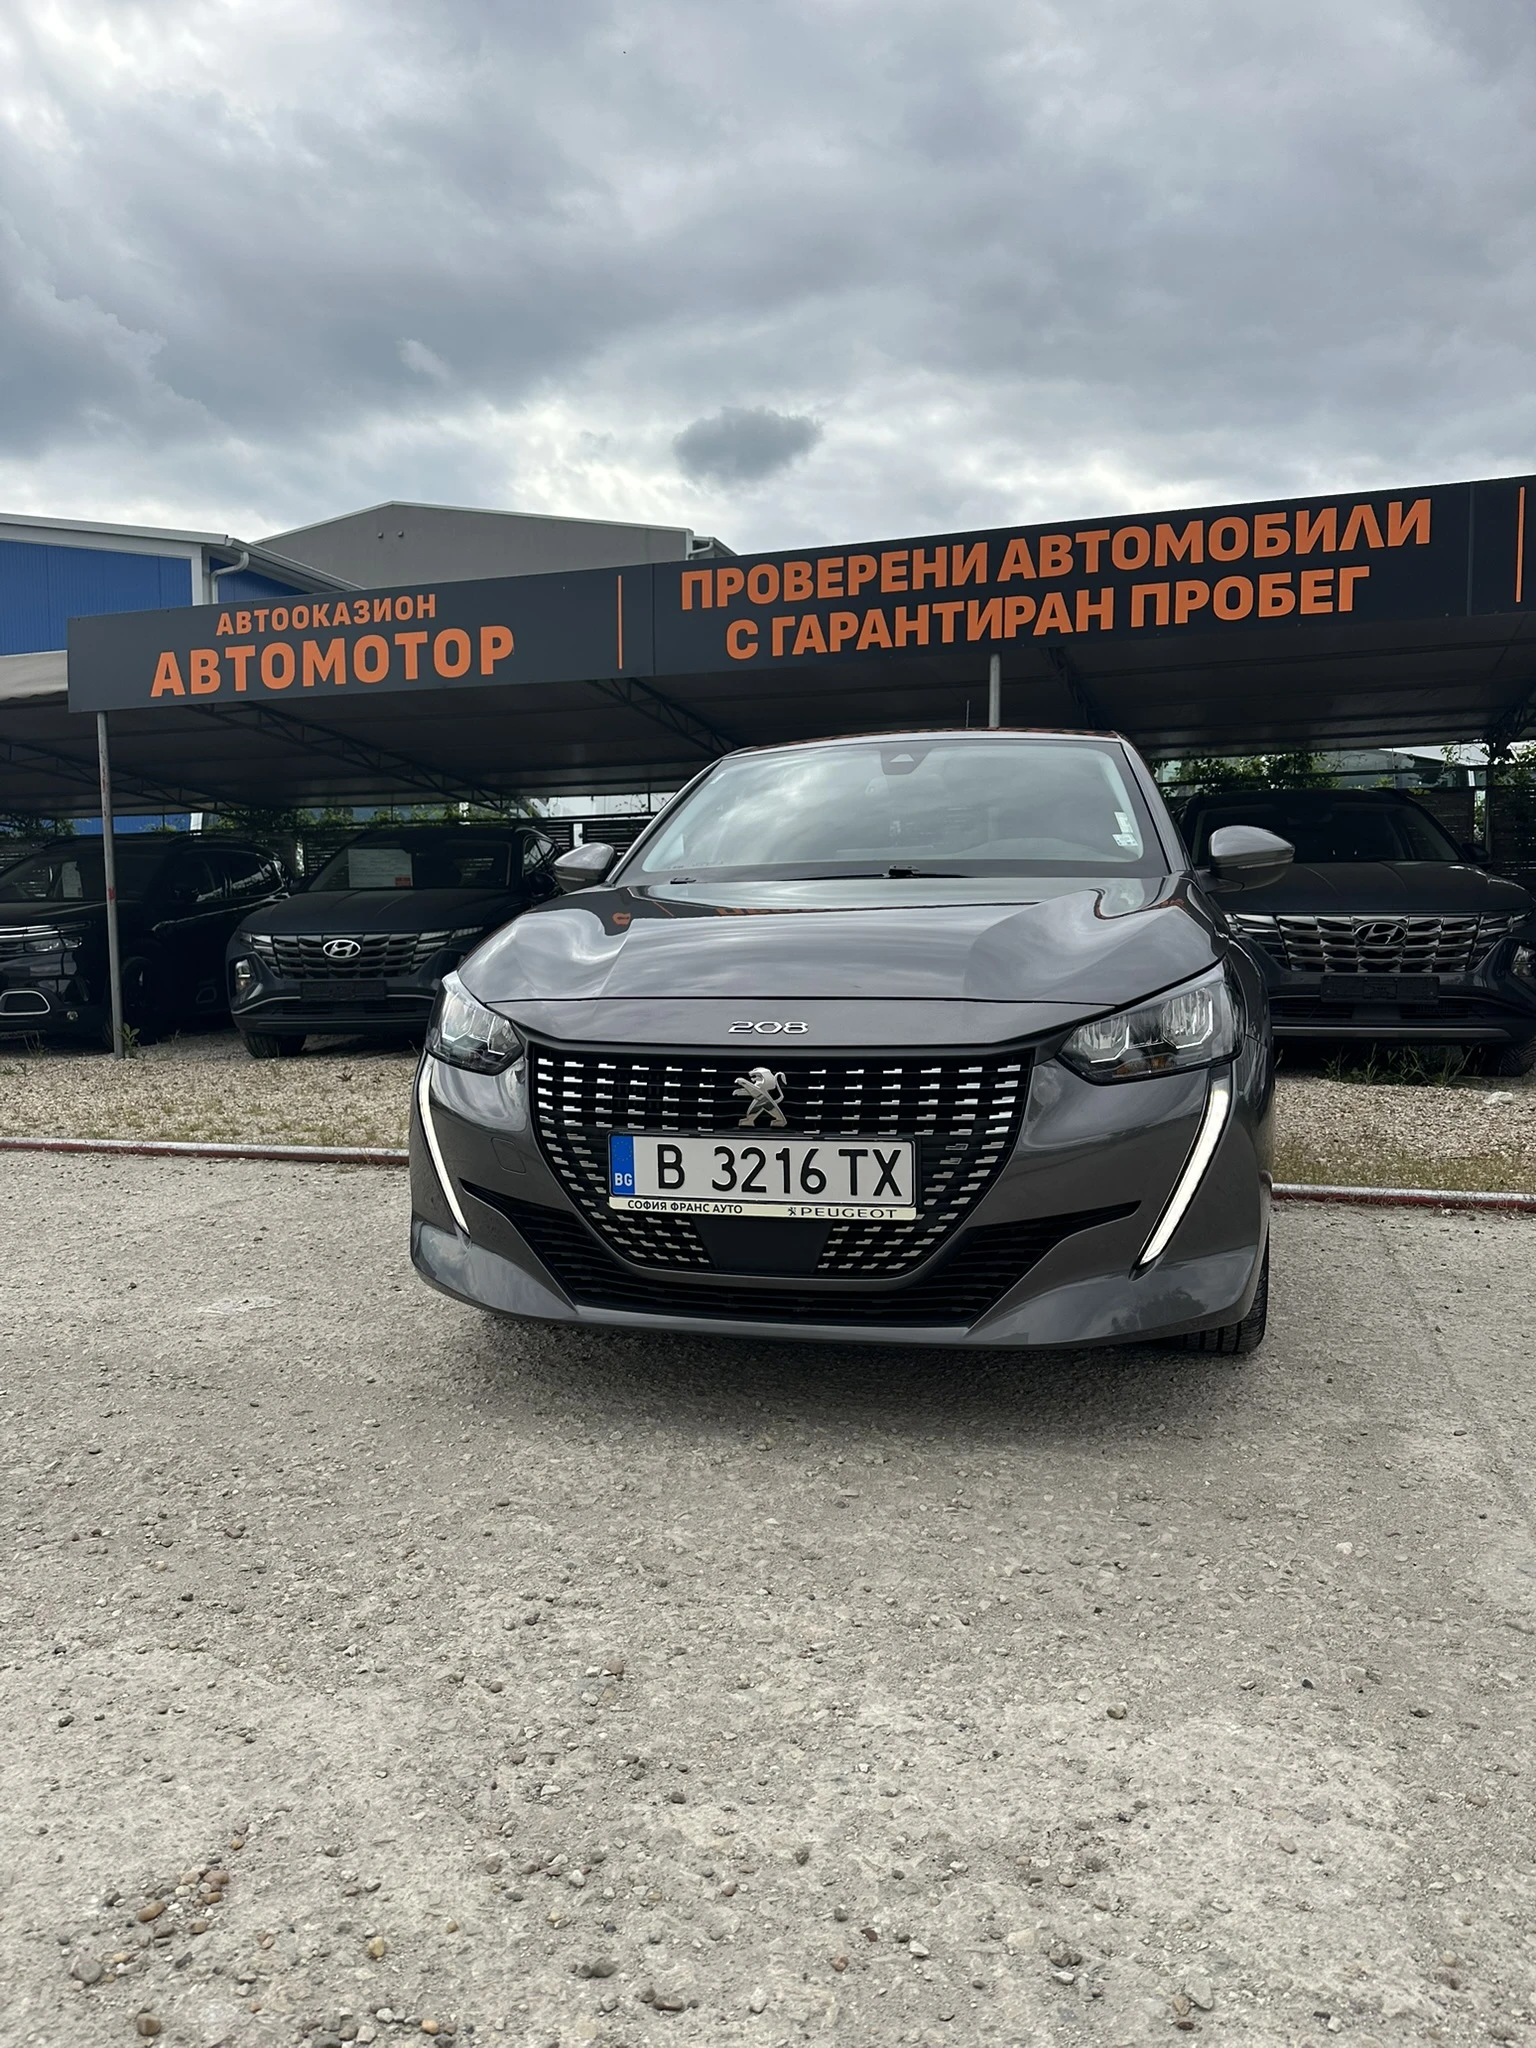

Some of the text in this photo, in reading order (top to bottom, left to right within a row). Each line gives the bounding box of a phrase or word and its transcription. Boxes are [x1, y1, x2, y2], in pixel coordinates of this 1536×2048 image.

[681, 498, 1432, 611] ПРОВЕРЕНИ АВТОМОБИЛИ
[215, 593, 437, 636] АВТООКАЗИОН
[726, 565, 1370, 660] С ГАРАНТИРАН ПРОБЕГ
[150, 625, 515, 698] АВТОМОТОР
[728, 1020, 809, 1034] 208
[614, 1172, 633, 1187] BG
[657, 1143, 903, 1197] B 3216 TX
[627, 1199, 743, 1214] СОФИЯ ФРАНС АУТО
[801, 1206, 897, 1219] PEUGEOT
